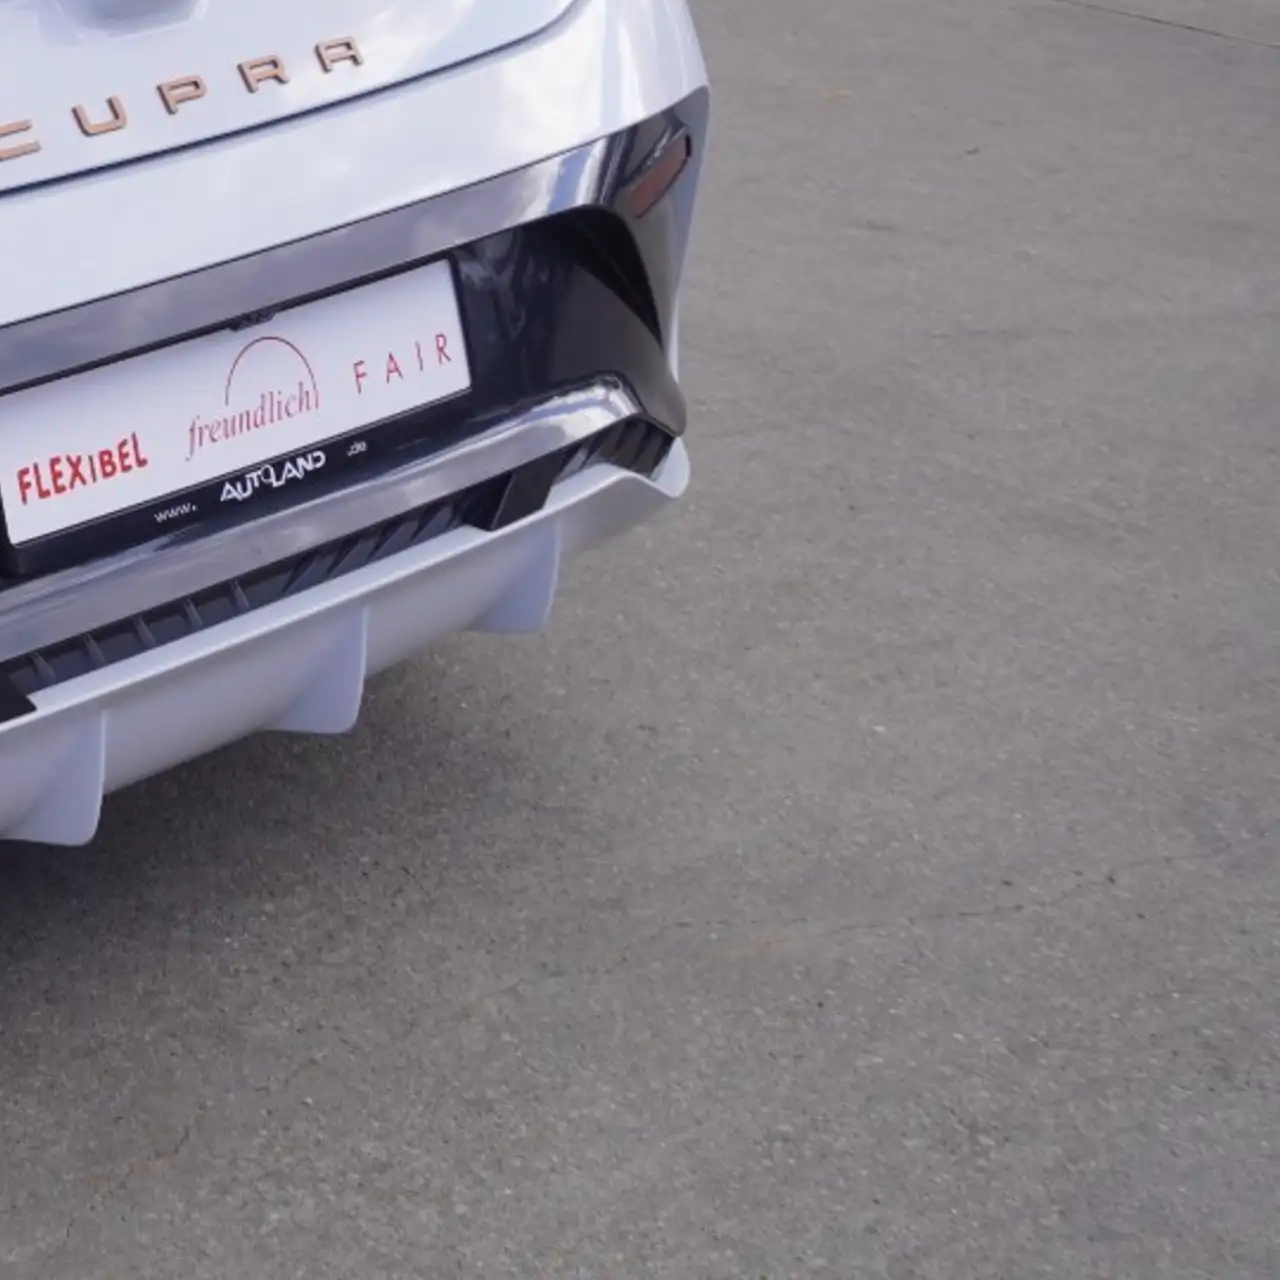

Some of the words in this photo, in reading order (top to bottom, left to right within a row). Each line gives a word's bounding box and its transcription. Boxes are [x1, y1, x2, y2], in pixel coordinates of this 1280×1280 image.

[17, 431, 148, 506] FLEXIBEL
[186, 380, 312, 462] freundlich
[352, 332, 452, 395] FAIR
